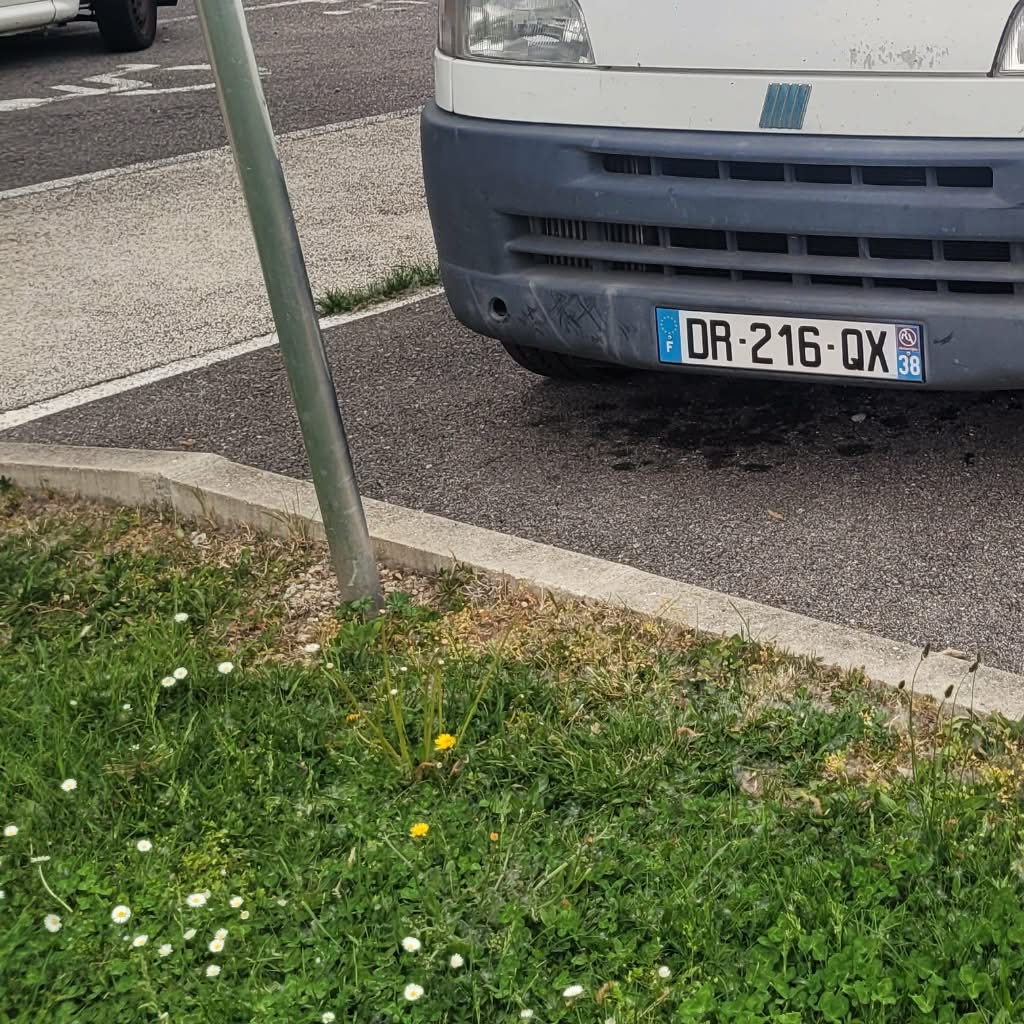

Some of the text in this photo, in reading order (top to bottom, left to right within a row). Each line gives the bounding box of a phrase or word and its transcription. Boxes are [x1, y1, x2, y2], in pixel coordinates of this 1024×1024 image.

[666, 341, 674, 352] F
[686, 317, 889, 372] DR-216-QX
[898, 354, 920, 376] 38
